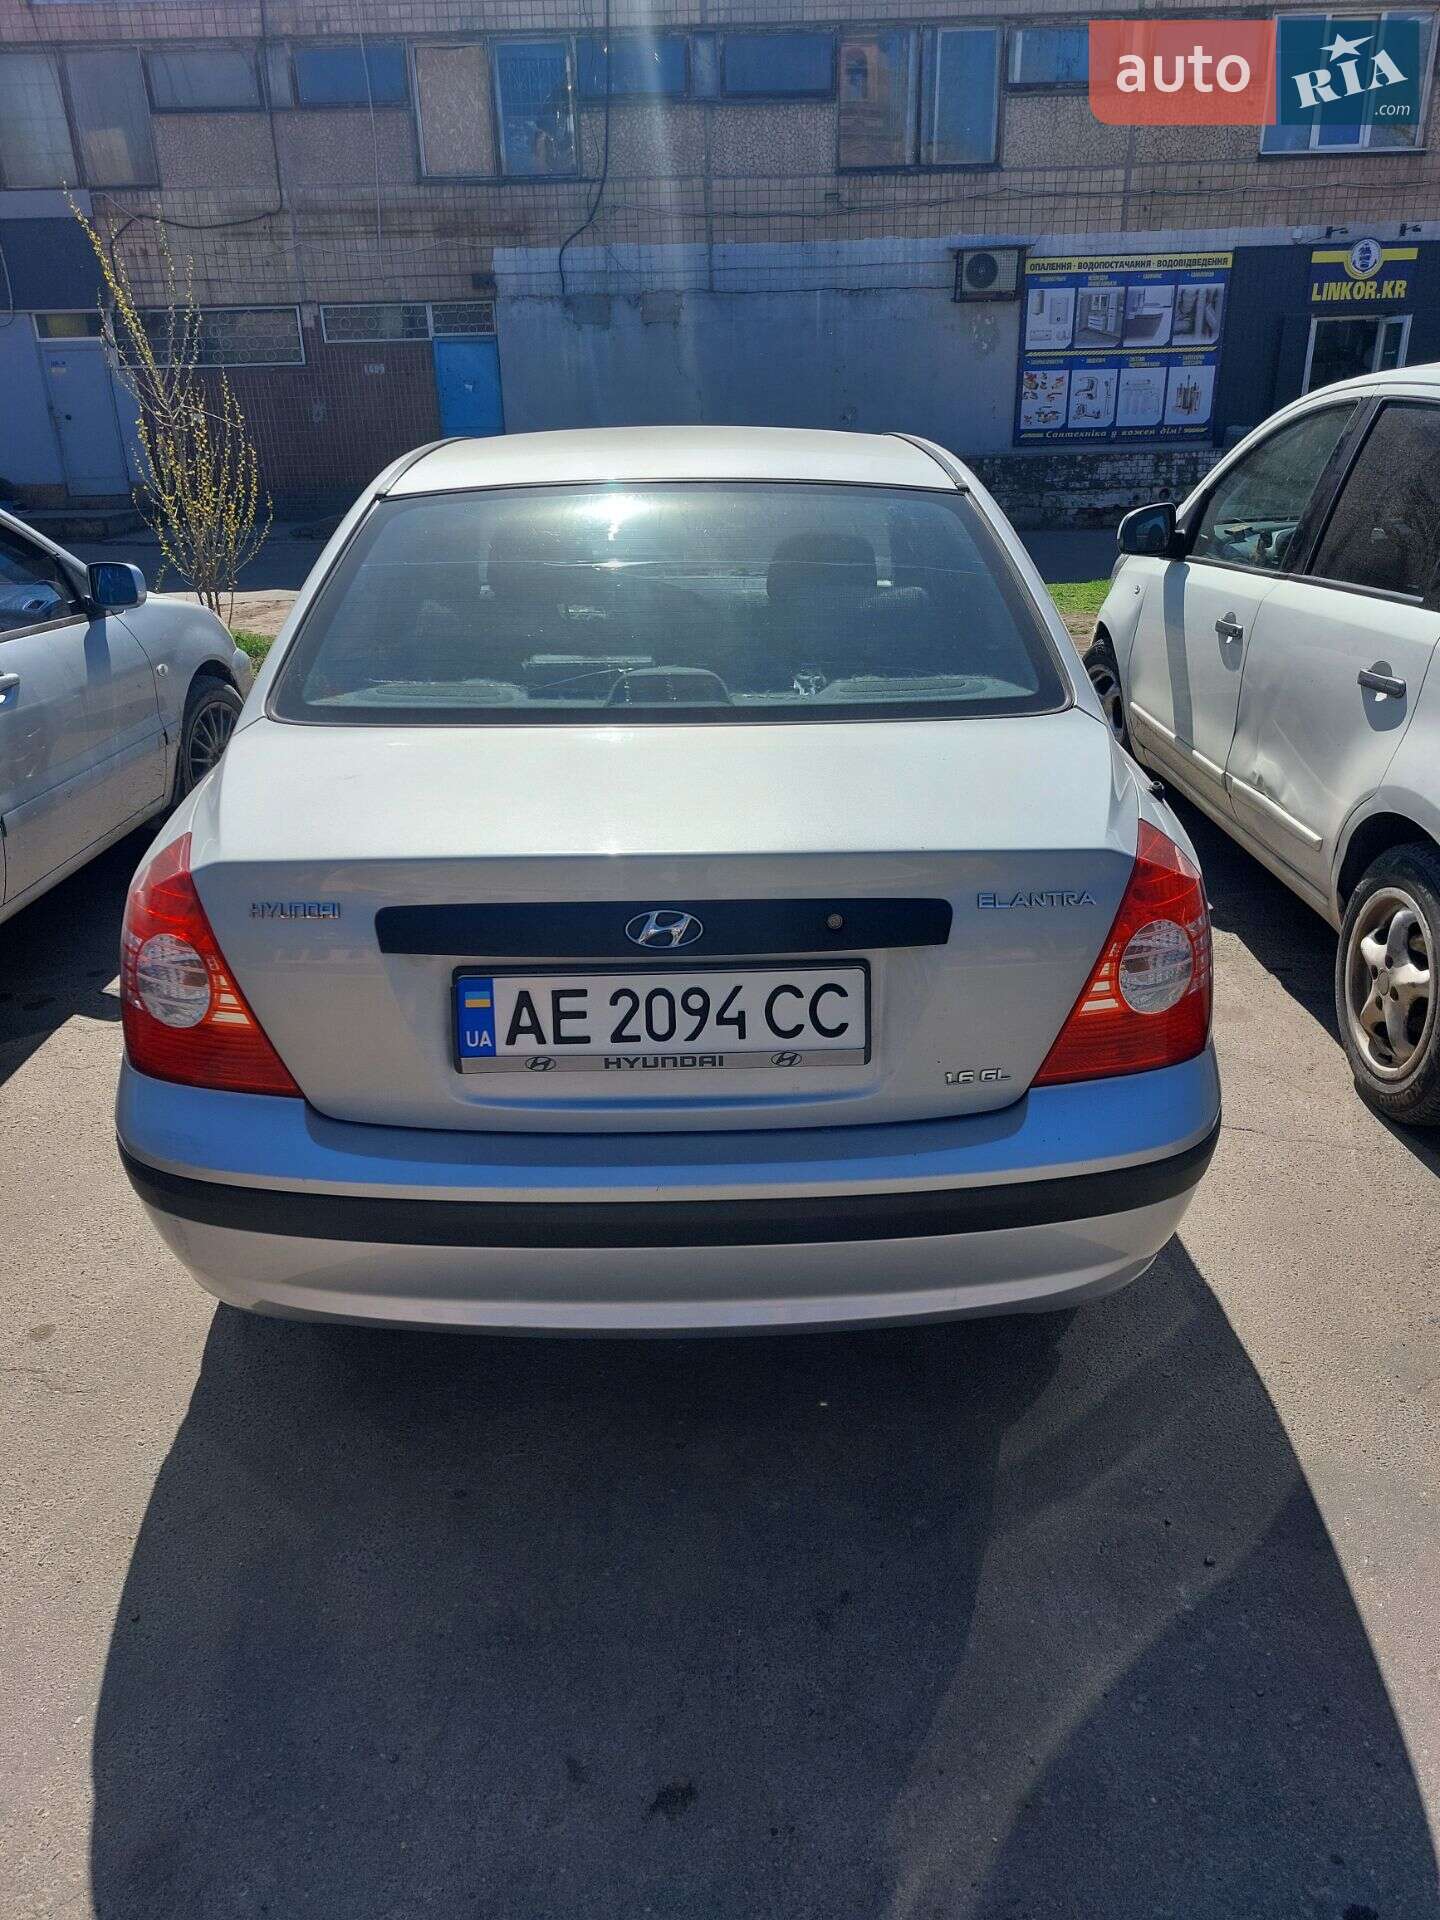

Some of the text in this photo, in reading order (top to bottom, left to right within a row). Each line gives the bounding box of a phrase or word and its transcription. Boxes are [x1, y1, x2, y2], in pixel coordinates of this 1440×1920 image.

[1029, 257, 1229, 272] ОПАЛЕННЯ ВОДОПОСТАЧАННЯ ВОДОВІДВЕДЕННЯ
[1311, 280, 1407, 301] LINKOR.KR
[977, 890, 1096, 909] ELANTRA
[249, 902, 342, 919] HYUNDAI
[505, 982, 849, 1046] AE 2094 CC
[466, 1031, 493, 1048] UA
[604, 1055, 725, 1070] HYUNDAI
[980, 1067, 1012, 1082] GL
